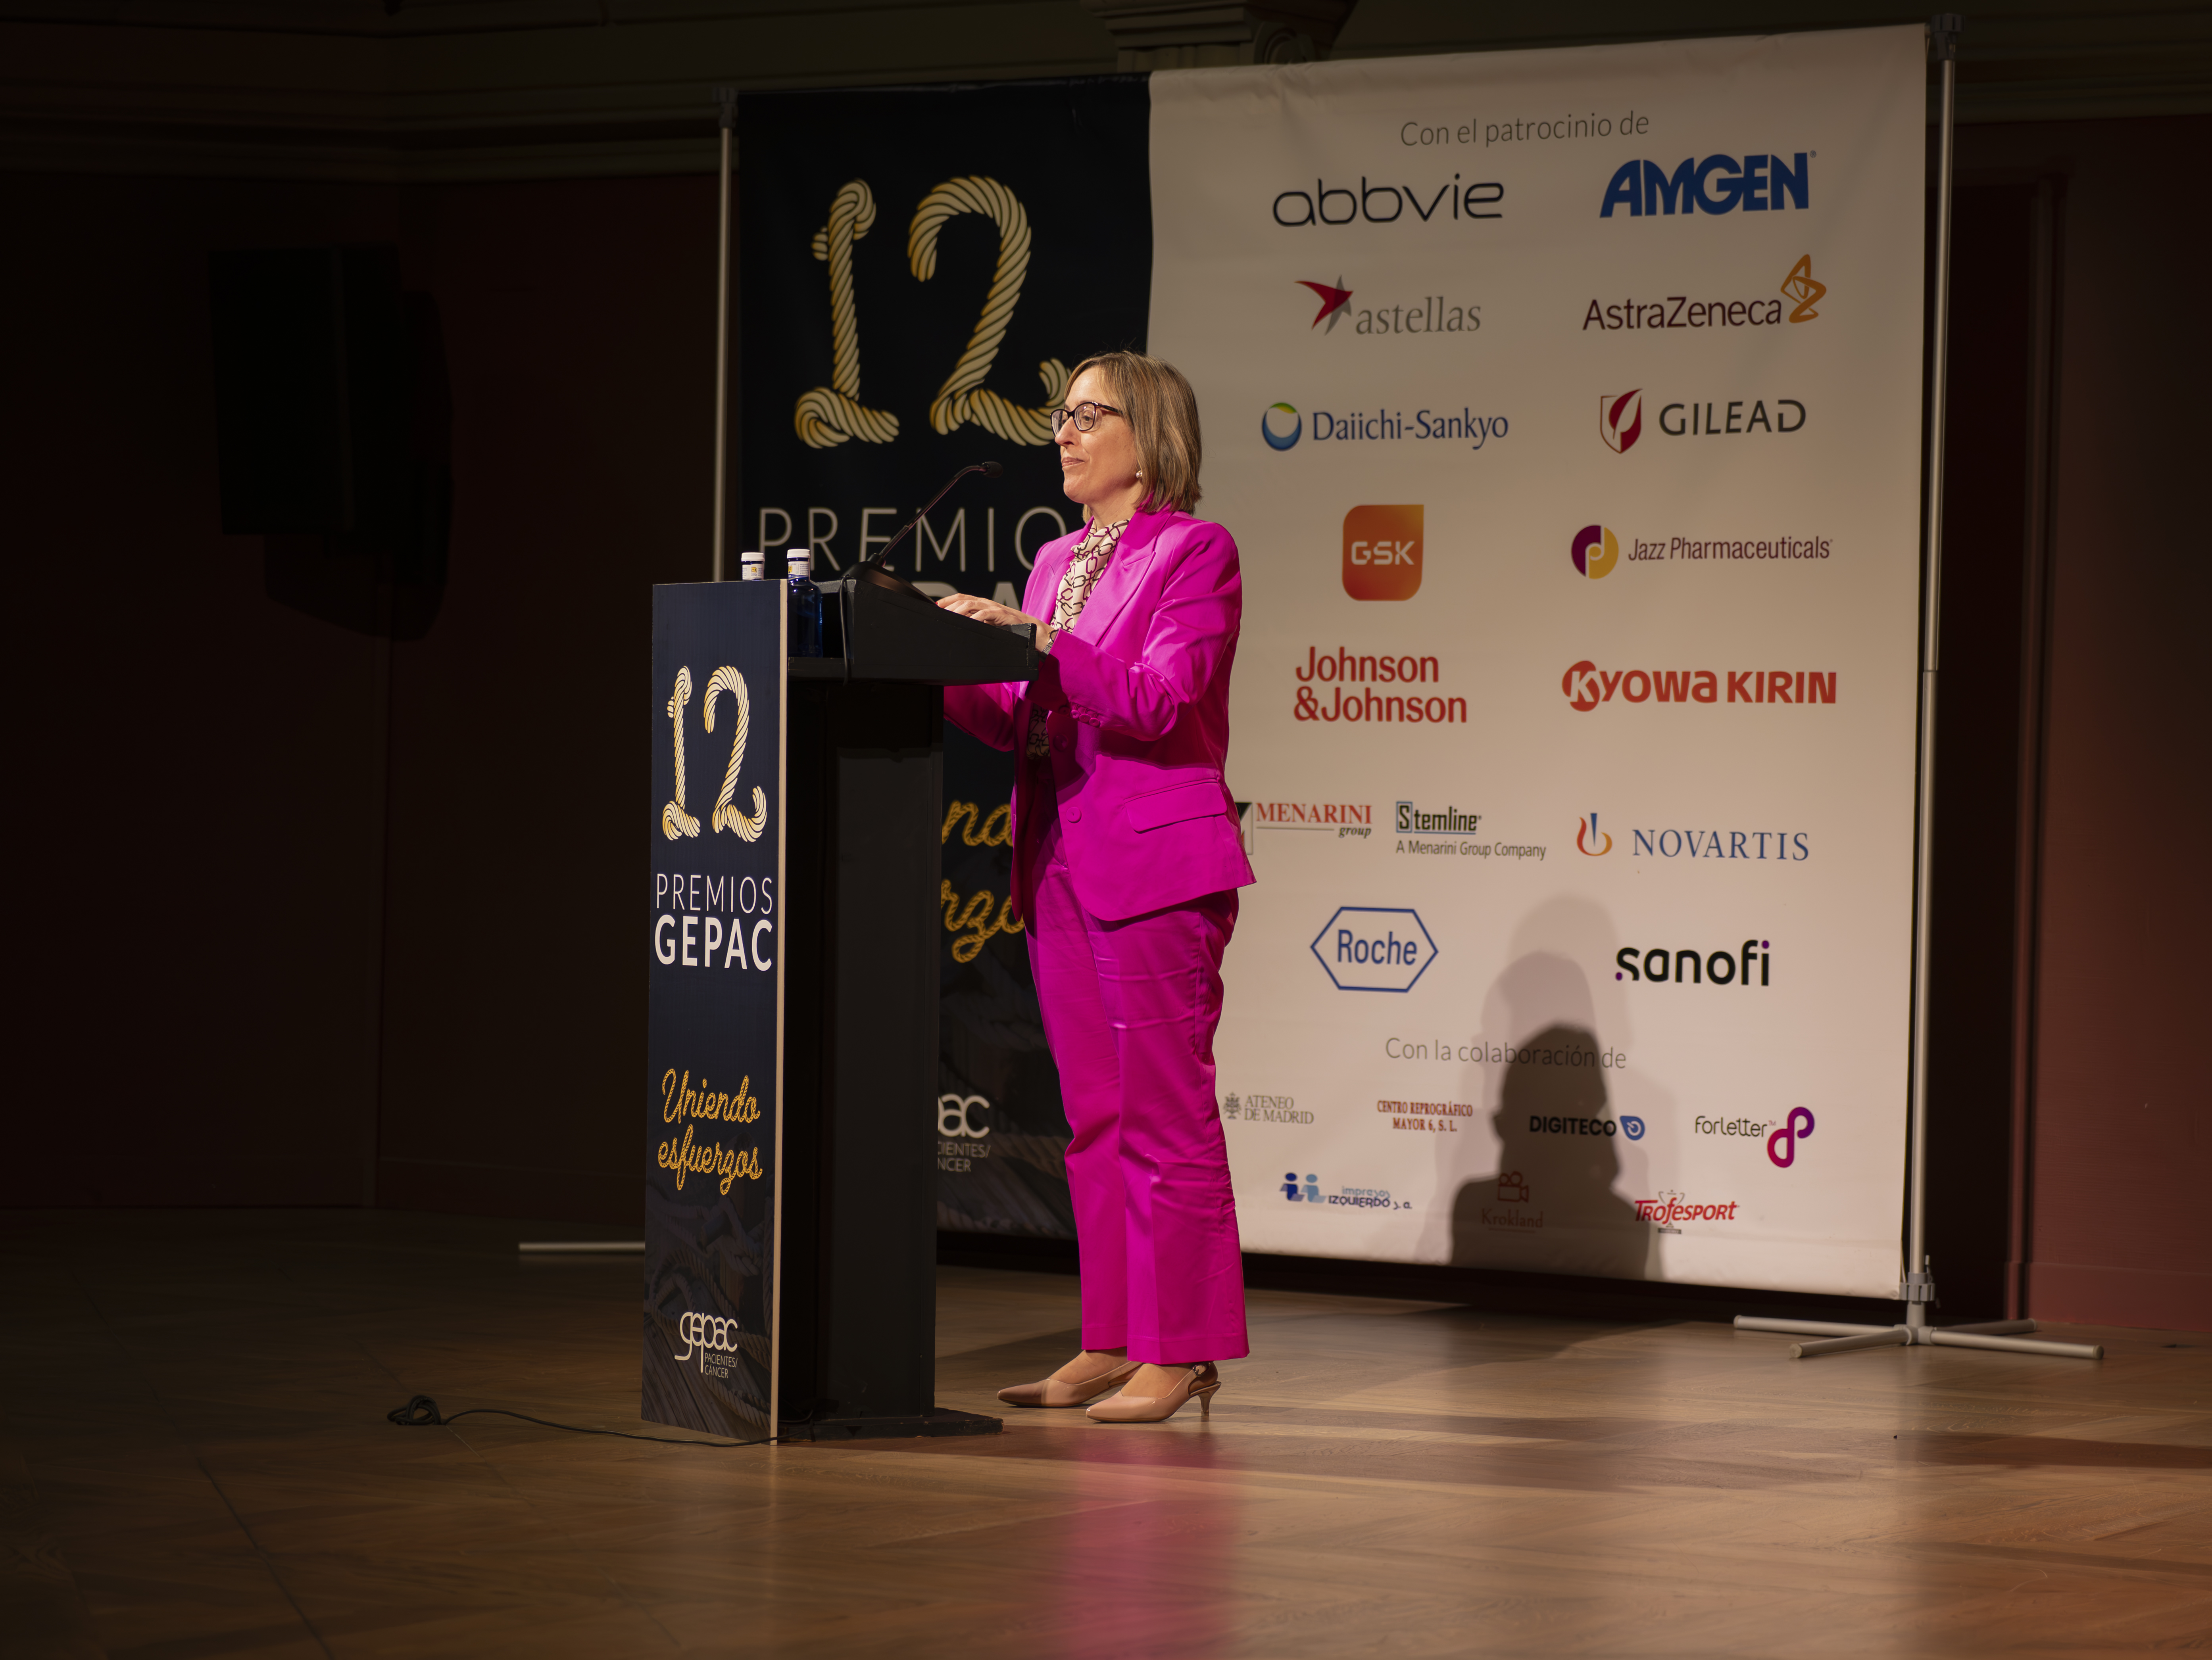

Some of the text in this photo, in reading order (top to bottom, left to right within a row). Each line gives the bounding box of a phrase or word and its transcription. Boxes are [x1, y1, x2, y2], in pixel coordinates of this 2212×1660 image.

[1401, 110, 1649, 148] Con el patrocinio de
[1272, 173, 1504, 227] abbvie
[795, 175, 1072, 448] 12
[1355, 297, 1481, 335] astellas
[1583, 297, 1781, 330] AstraZeneca
[1313, 407, 1509, 450] Daiichi-Sankyo
[1659, 399, 1806, 437] GILEAD
[759, 507, 1067, 572] PREMIO
[1351, 541, 1414, 566] GSK
[1628, 536, 1830, 561] Jazz Pharmaceuticals
[1296, 647, 1439, 683] Johnson
[1727, 671, 1836, 704] KIRIN
[662, 666, 767, 842] 12
[1257, 803, 1372, 824] MENARINI
[1399, 804, 1476, 832] Stemline
[1339, 826, 1372, 839] group
[1632, 828, 1809, 861] NOVARTIS
[1396, 841, 1546, 860] A Menarini Group Company
[656, 873, 772, 914] PREMIOS
[655, 914, 772, 971] GEPAC
[1337, 929, 1417, 965] Roche
[1616, 940, 1770, 986] sanofi
[1386, 1038, 1626, 1068] Con la colaboración de
[662, 1068, 761, 1124] Uniendo
[1245, 1095, 1294, 1109] ATENEO
[1377, 1100, 1473, 1116] CENTRO REPROGRÁFICO
[1245, 1109, 1314, 1124] DE MADRID
[1393, 1117, 1426, 1131] MAYOR
[1530, 1115, 1617, 1137] DIGITECO
[1695, 1116, 1767, 1137] forletter
[658, 1124, 763, 1195] esfuerzos
[938, 1157, 971, 1172] NCER
[1482, 1208, 1543, 1228] Krokland
[675, 1312, 738, 1373] gepac
[705, 1364, 728, 1378] CÁNCER
